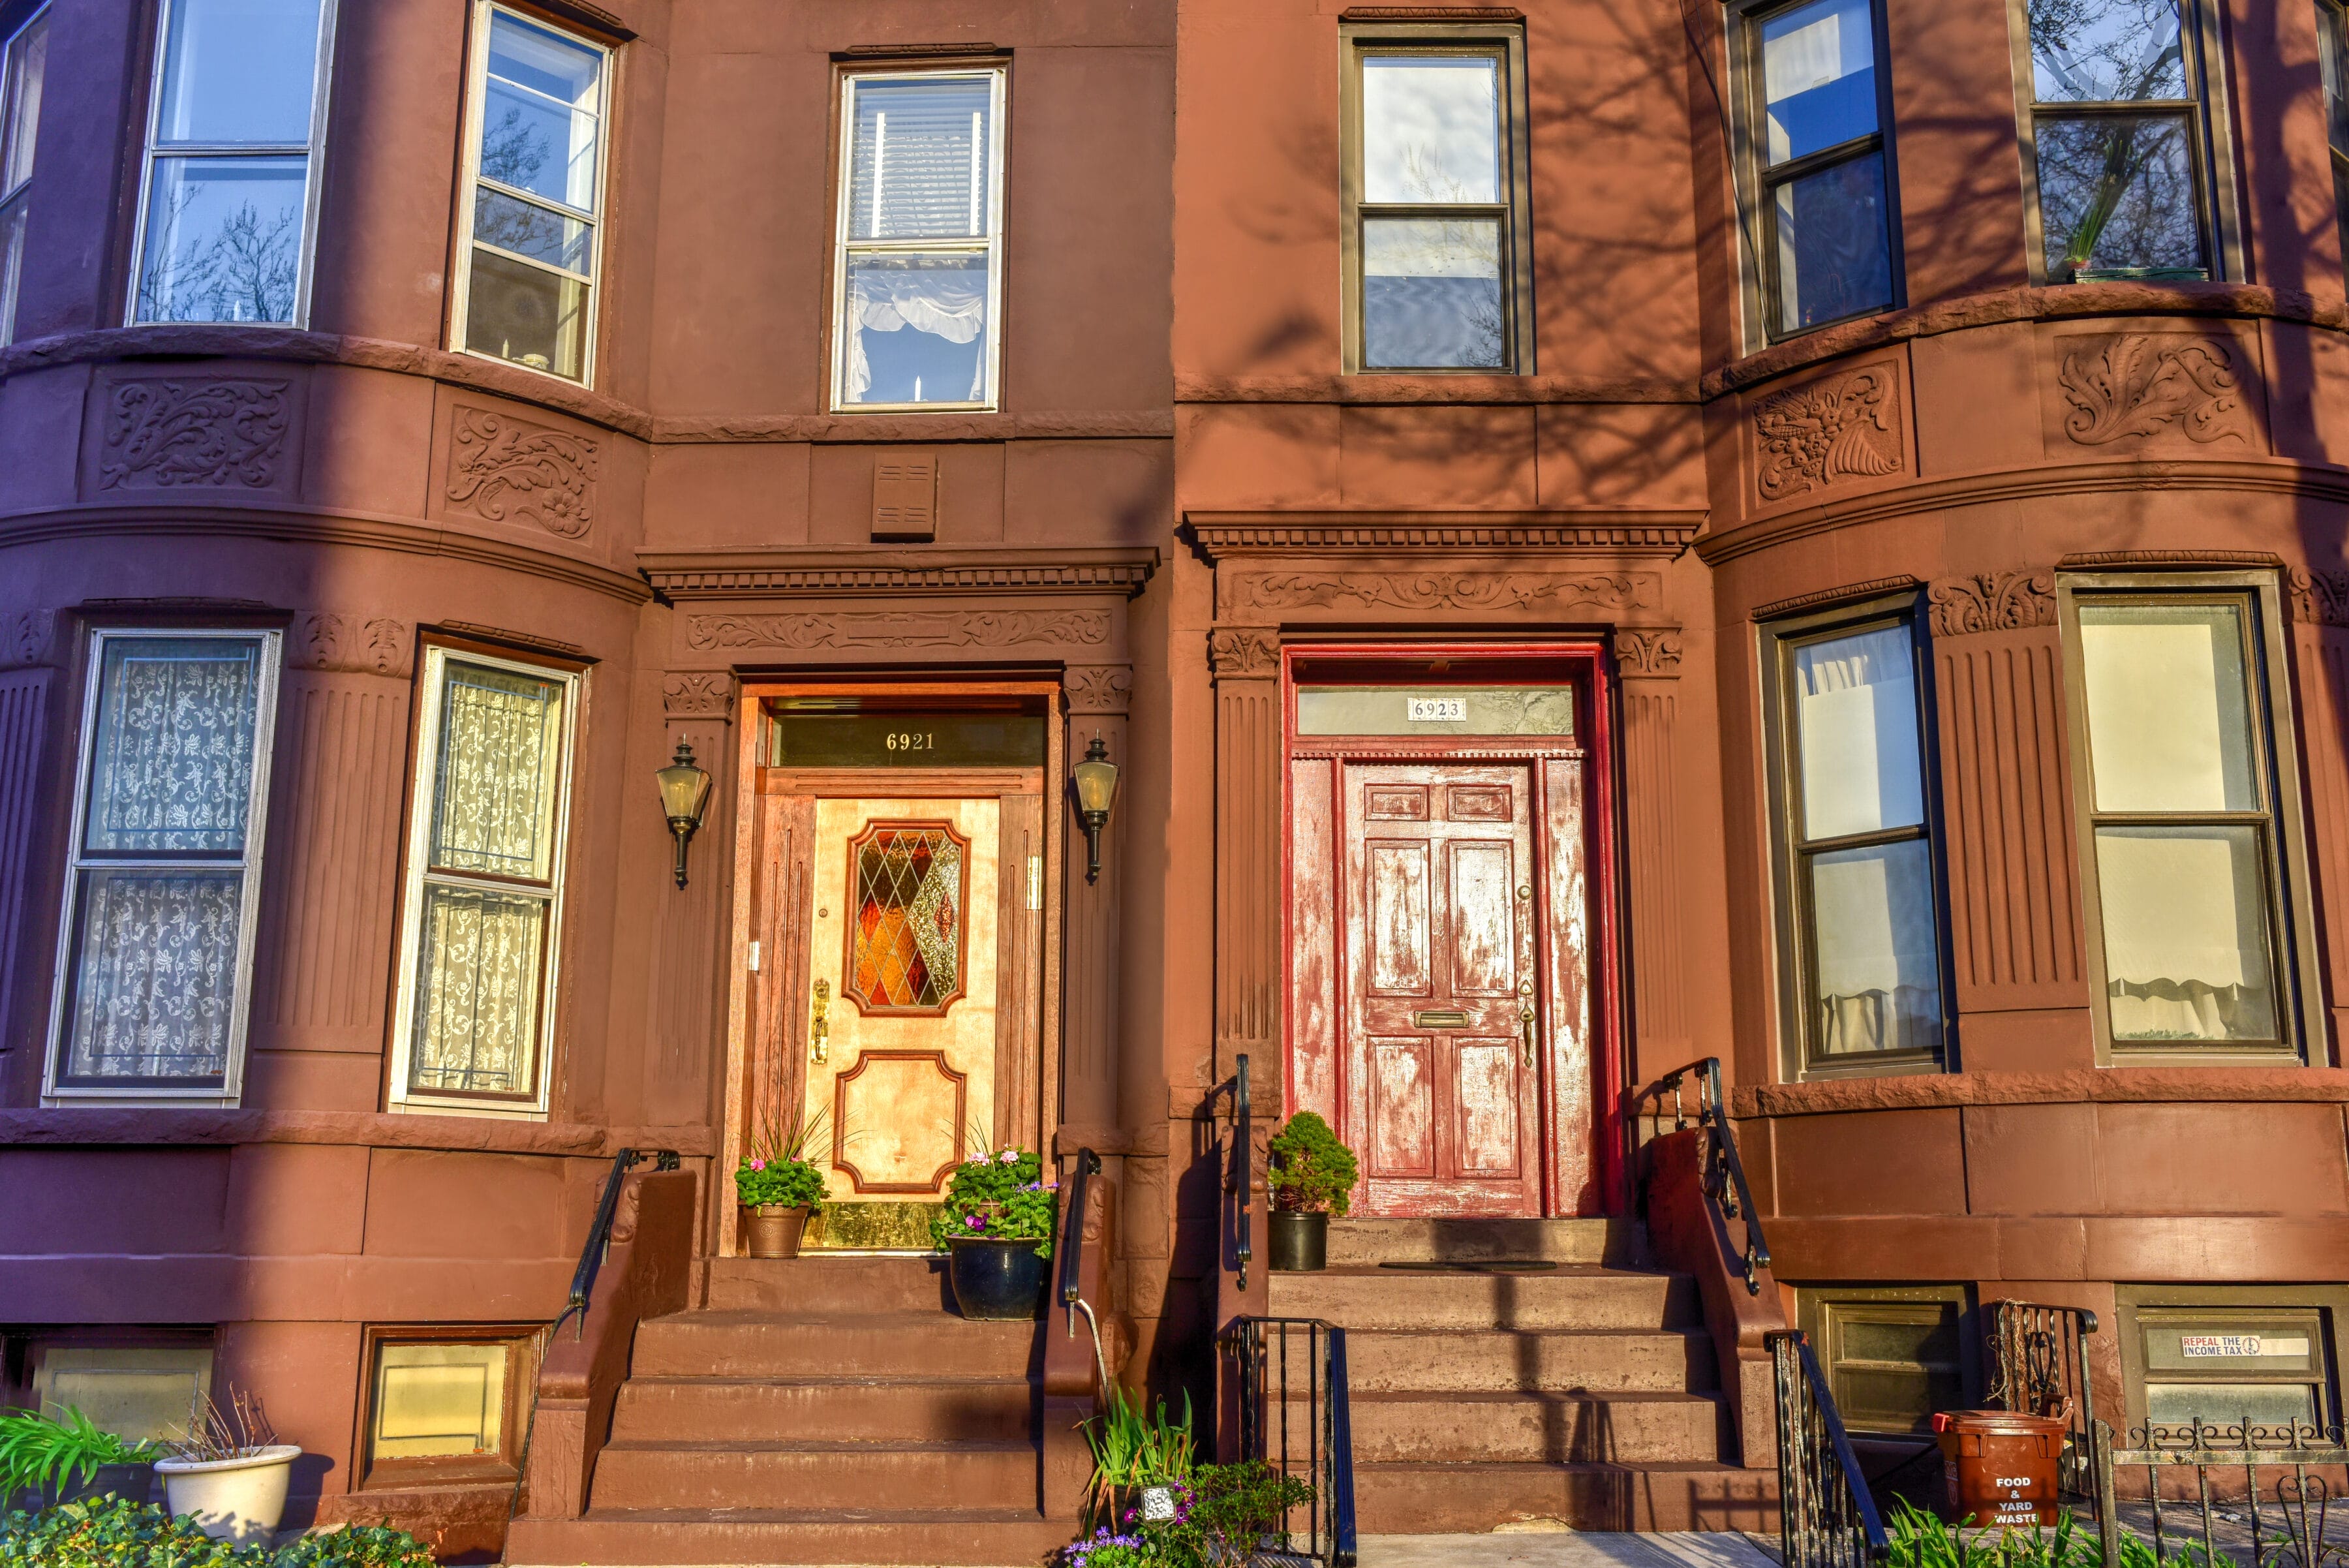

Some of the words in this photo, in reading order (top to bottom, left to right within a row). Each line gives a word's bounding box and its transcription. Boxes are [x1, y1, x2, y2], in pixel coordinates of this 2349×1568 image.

[1415, 703, 1459, 716] 6923
[887, 733, 934, 750] 6921
[2183, 1337, 2219, 1346] REPEAL
[2222, 1337, 2241, 1345] THE
[2185, 1346, 2222, 1355] INCOME
[2224, 1346, 2243, 1355] TAX
[1996, 1477, 2031, 1487] FOOD
[2010, 1490, 2020, 1499] &
[1999, 1501, 2033, 1511] YARD
[1995, 1513, 2036, 1524] WASTE
